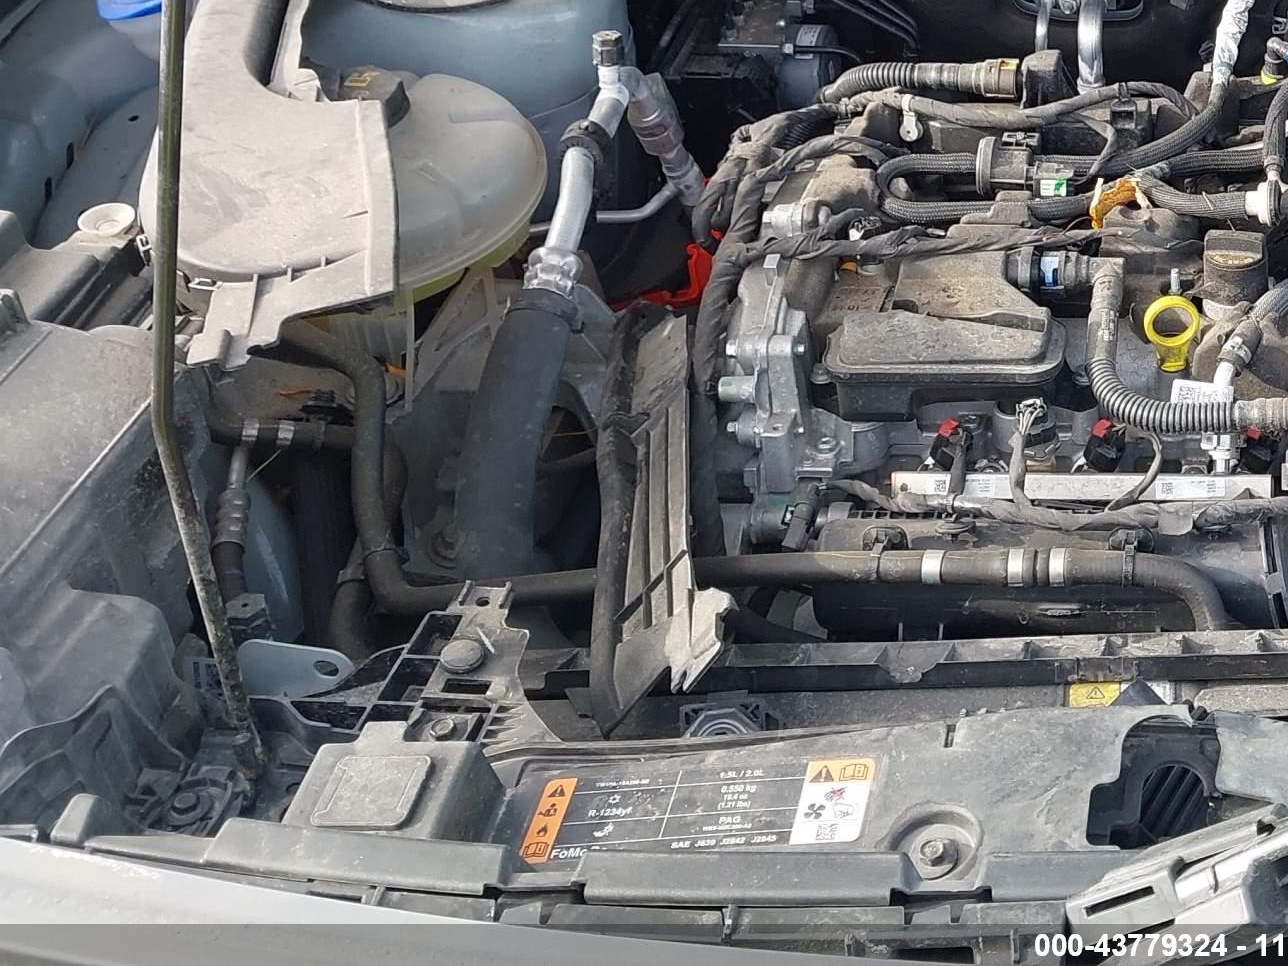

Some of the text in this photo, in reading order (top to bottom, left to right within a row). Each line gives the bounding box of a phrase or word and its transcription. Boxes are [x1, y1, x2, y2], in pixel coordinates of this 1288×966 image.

[720, 785, 757, 794] 0.550 kg
[588, 807, 632, 820] R-1234yf
[718, 816, 742, 824] PAG
[670, 841, 691, 850] SAE
